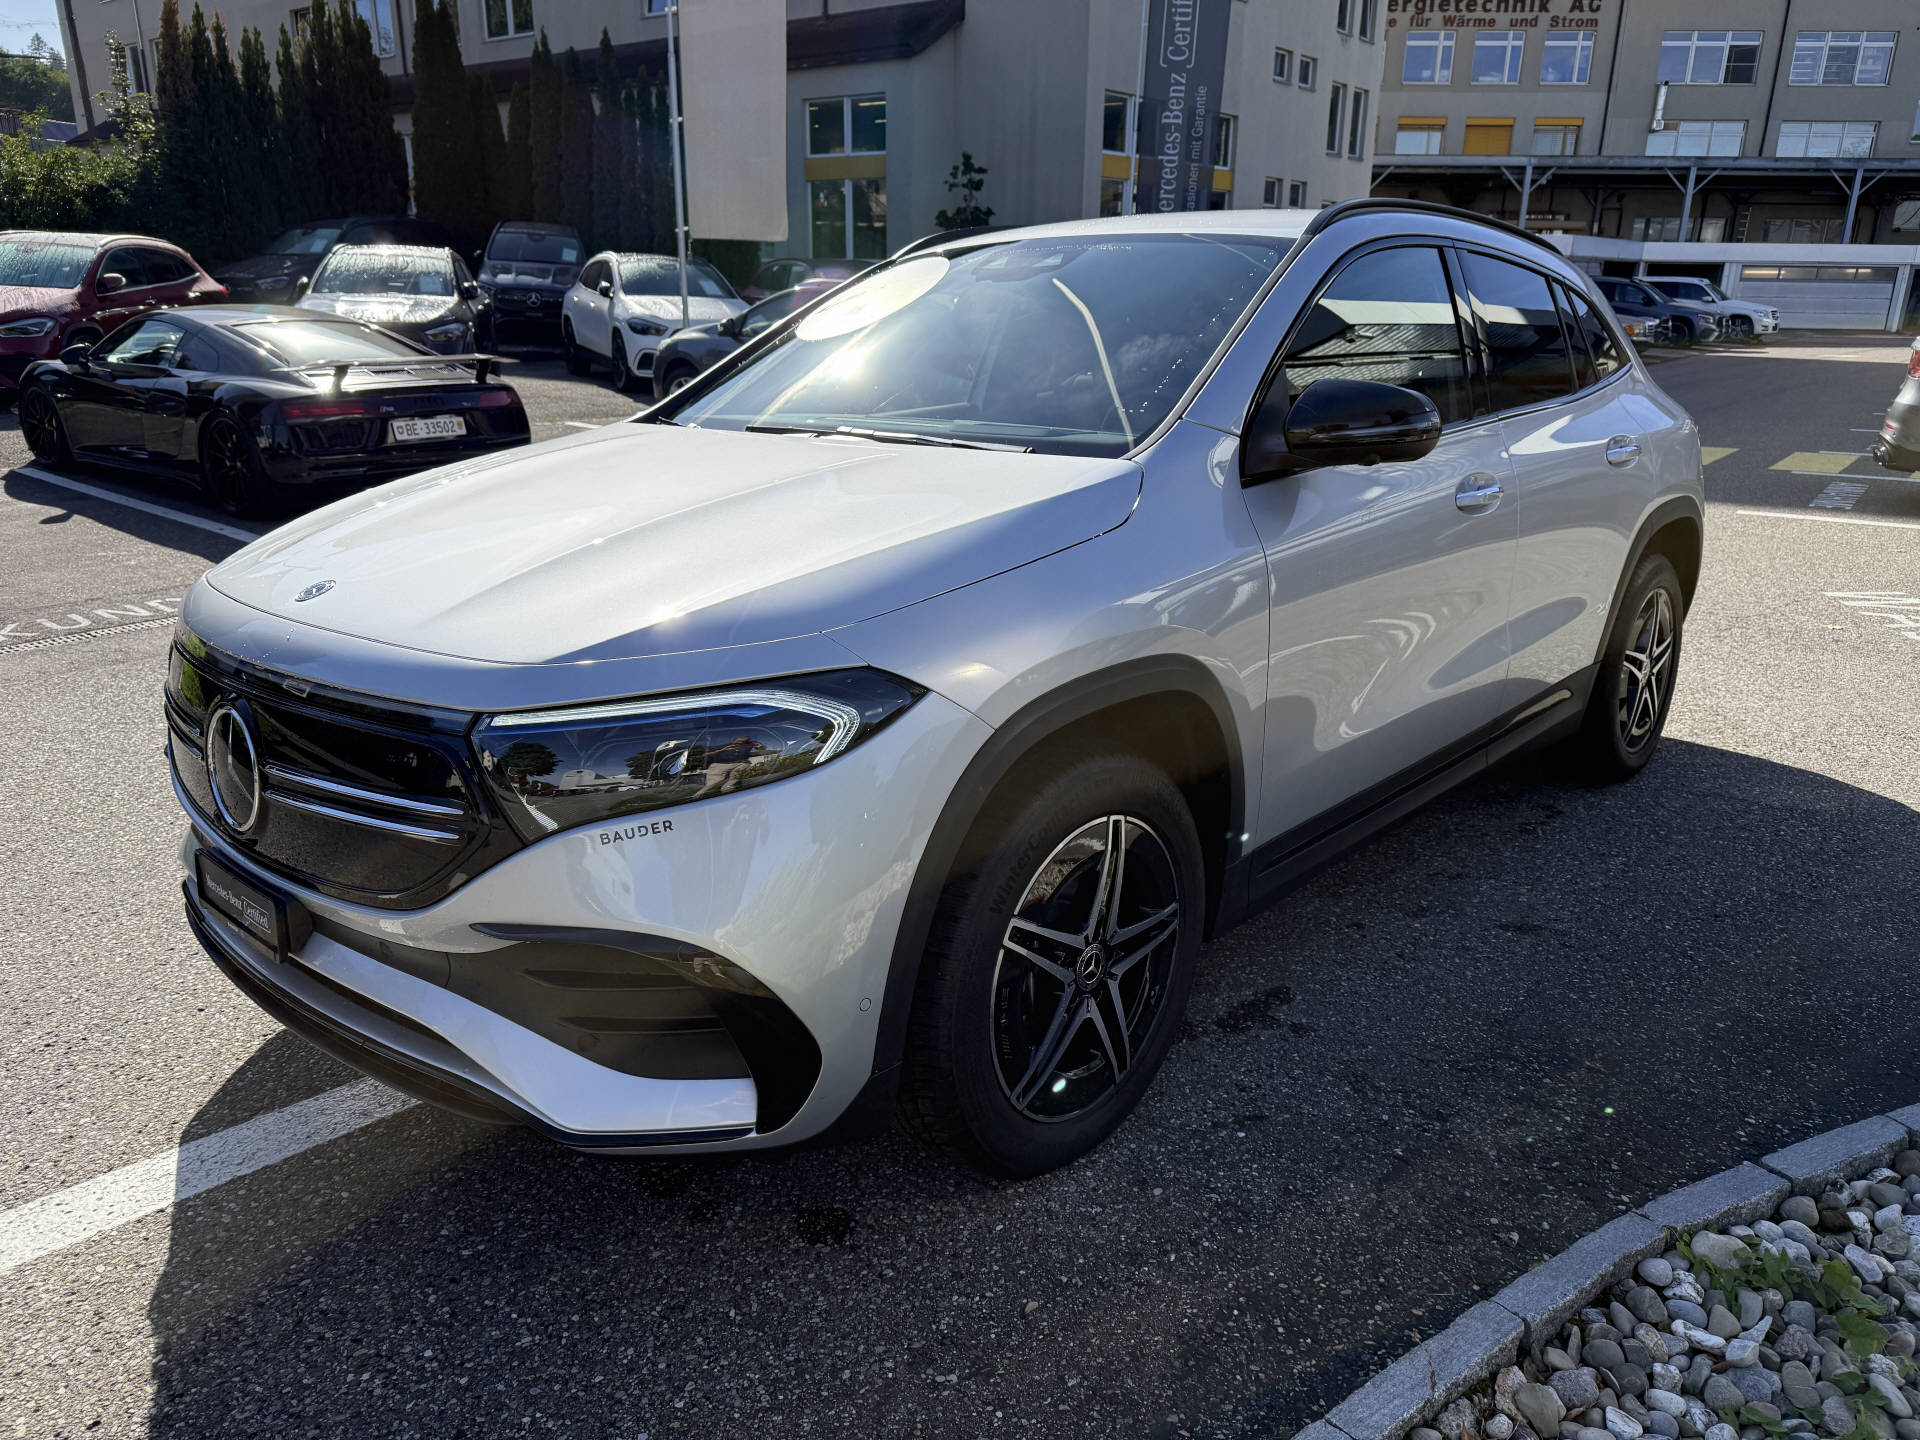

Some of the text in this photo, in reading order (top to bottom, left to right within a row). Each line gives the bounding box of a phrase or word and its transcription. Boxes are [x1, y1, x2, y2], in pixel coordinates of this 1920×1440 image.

[1409, 14, 1432, 28] für
[1442, 14, 1497, 28] Wärme
[1509, 15, 1539, 28] und
[1548, 15, 1599, 28] Strom
[1191, 85, 1208, 137] Garantie
[599, 819, 674, 846] BAUDER
